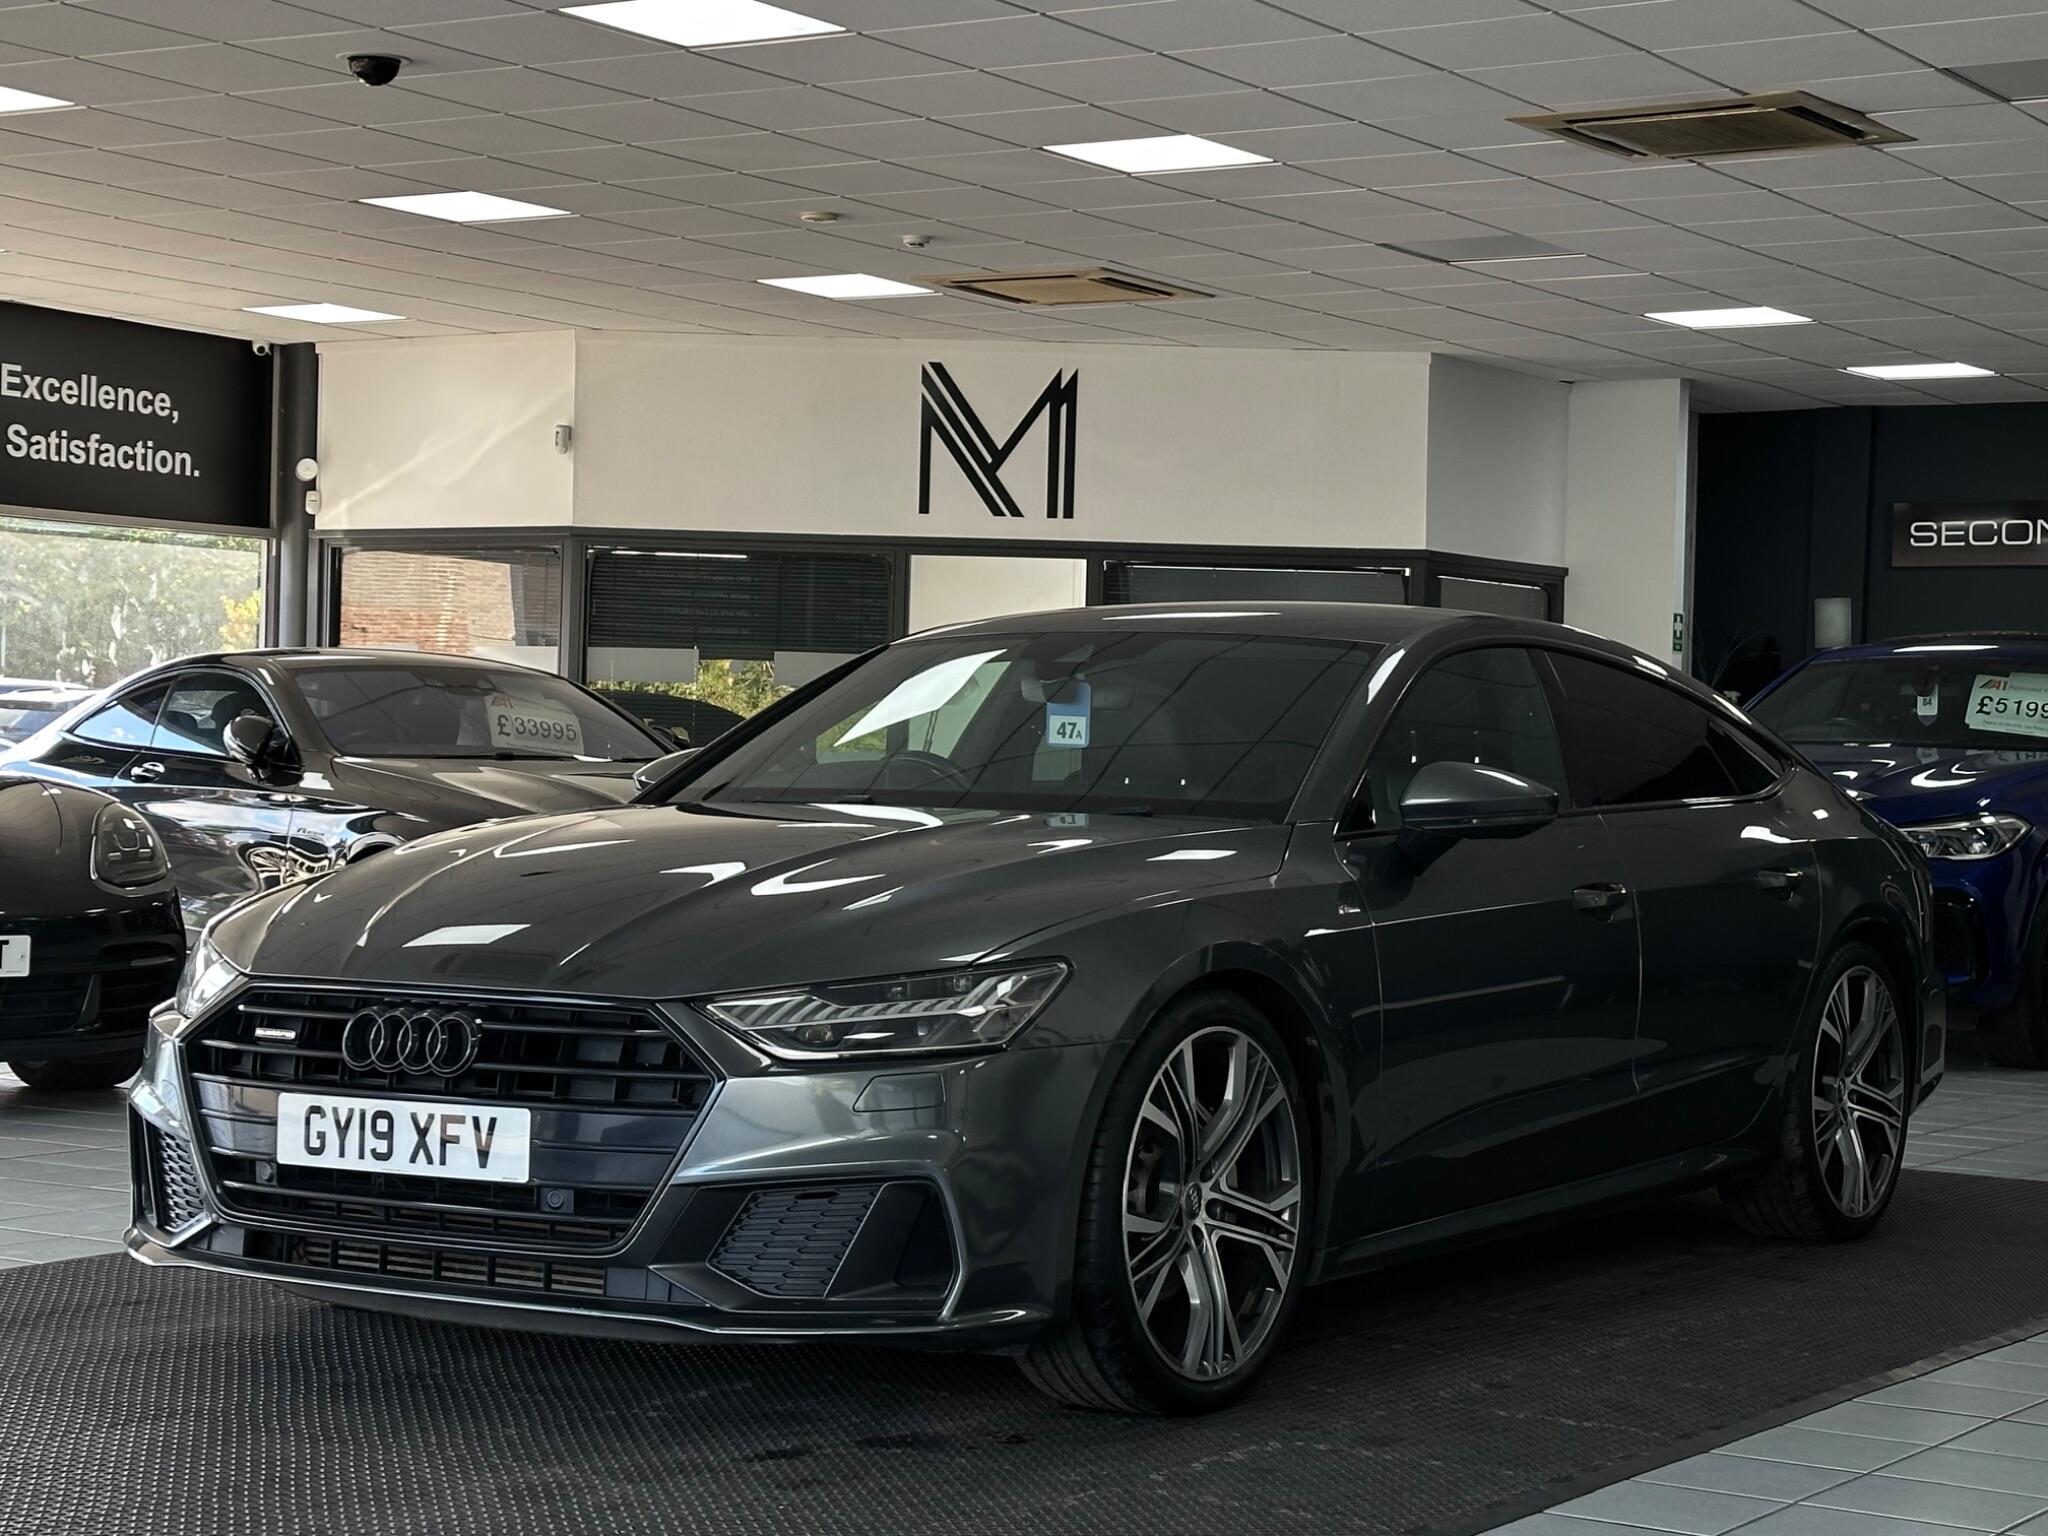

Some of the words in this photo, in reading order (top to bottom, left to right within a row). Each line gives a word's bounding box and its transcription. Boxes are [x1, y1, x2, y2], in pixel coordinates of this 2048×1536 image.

[1, 363, 179, 424] Excellence,
[5, 423, 201, 478] Satisfaction.
[497, 714, 577, 741] £33995
[304, 1105, 394, 1162] GY19
[409, 1112, 498, 1169] XFV
